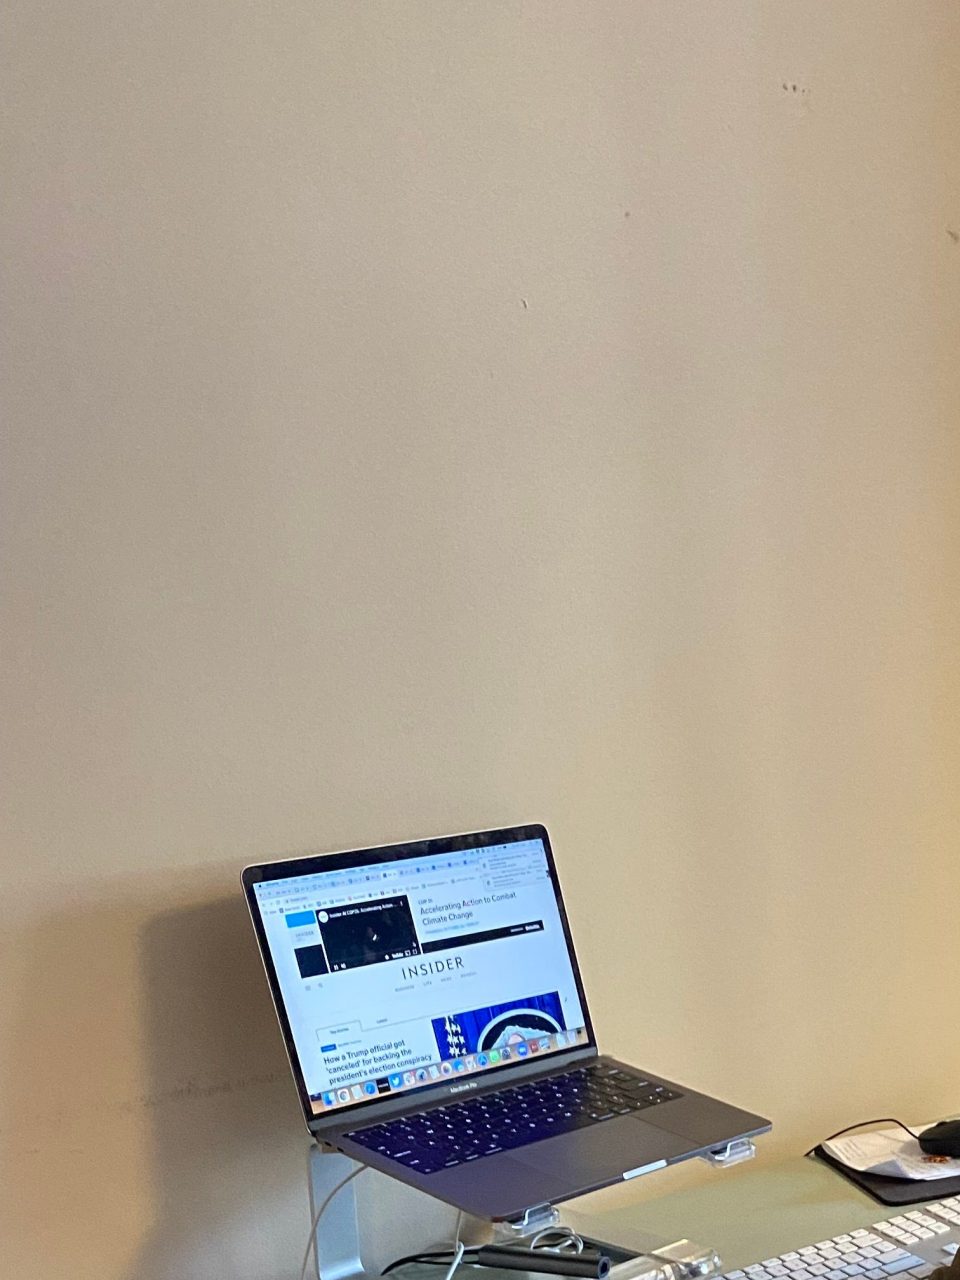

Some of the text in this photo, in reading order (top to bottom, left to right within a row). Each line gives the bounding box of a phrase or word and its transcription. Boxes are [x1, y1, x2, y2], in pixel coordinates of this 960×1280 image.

[420, 892, 517, 916] Accelerating Action to Combat
[422, 911, 474, 927] Climate Change
[401, 956, 465, 980] INSIDER
[323, 1055, 341, 1065] How
[347, 1049, 369, 1061] Trump
[369, 1042, 393, 1055] official
[393, 1040, 405, 1051] got
[362, 1057, 373, 1066] for
[373, 1052, 400, 1065] backing
[400, 1049, 412, 1058] the
[329, 1054, 433, 1085] president's election conspiracy
